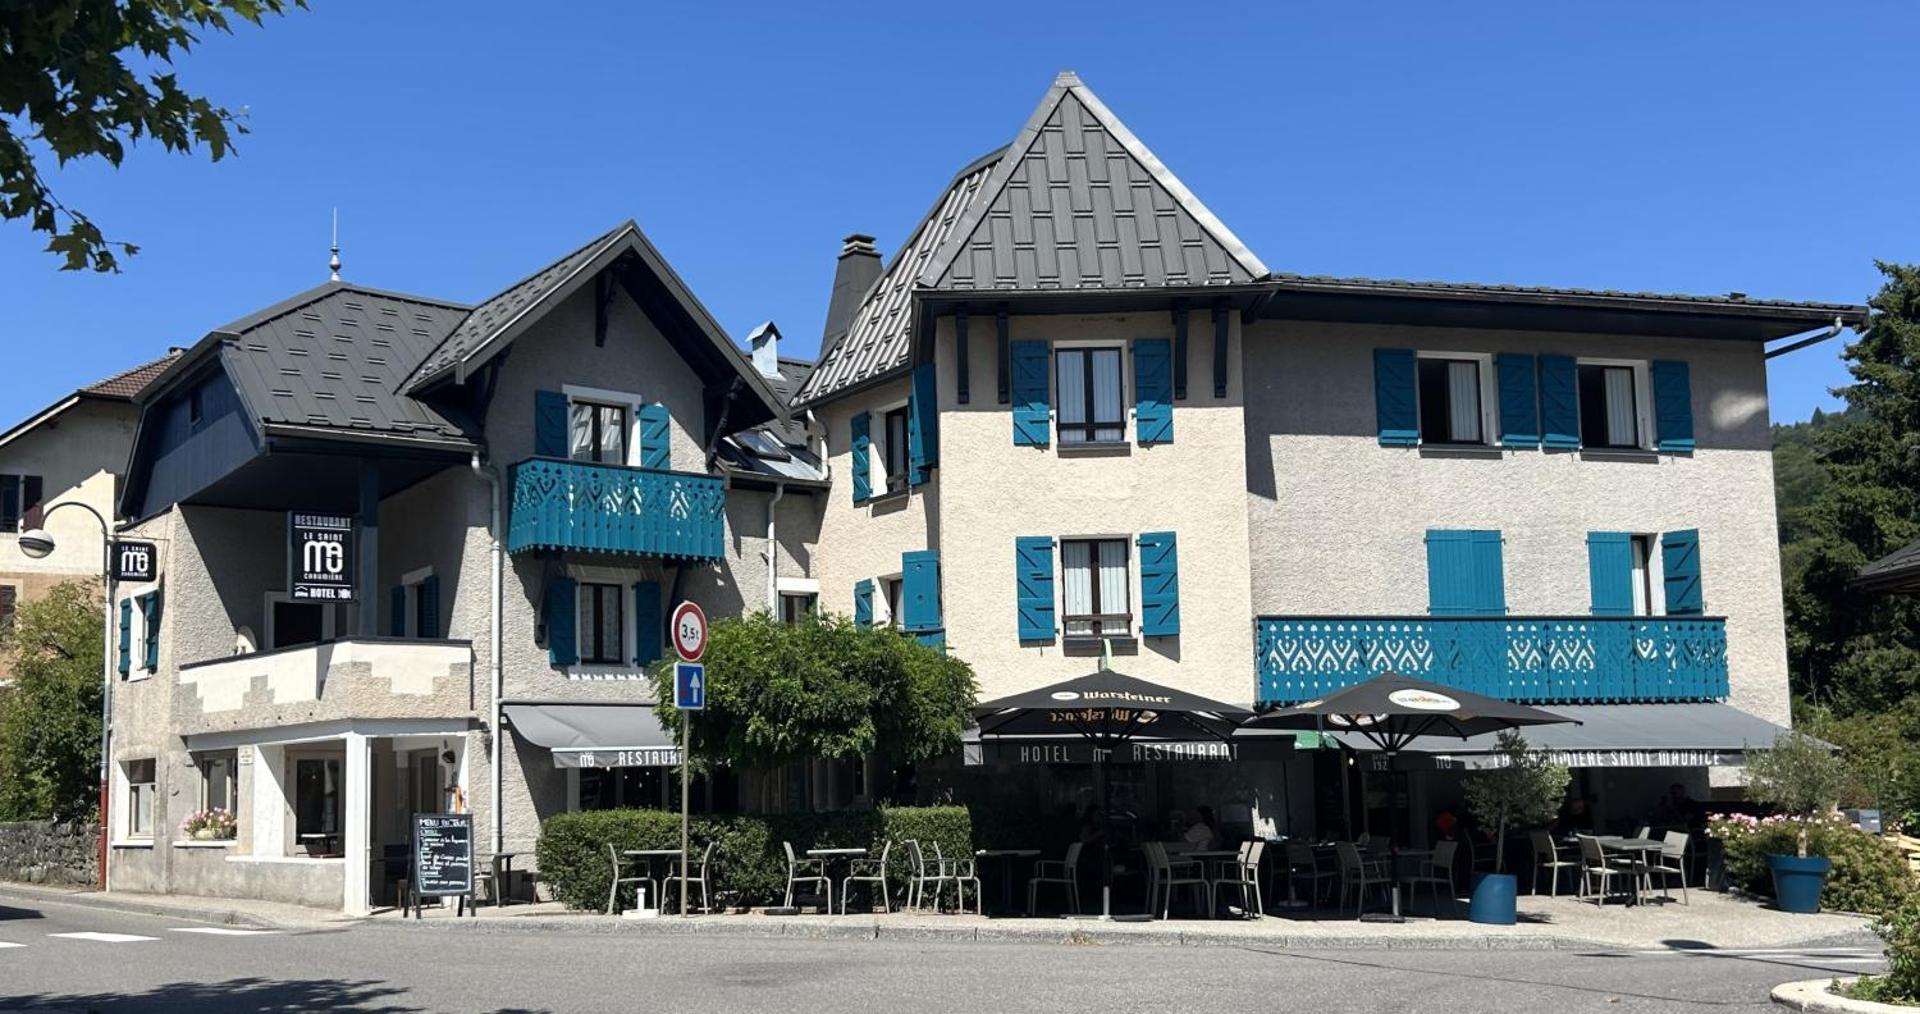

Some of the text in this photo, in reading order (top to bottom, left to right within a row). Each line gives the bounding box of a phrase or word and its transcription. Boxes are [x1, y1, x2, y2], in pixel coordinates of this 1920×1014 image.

[294, 514, 352, 528] RESTAURANT
[310, 588, 336, 598] HOTEL
[681, 624, 700, 641] 3,5t
[1083, 691, 1172, 703] Warsteiner
[618, 750, 683, 766] RESTAUR
[1020, 743, 1239, 763] HOTEL RESTAURANT
[1610, 751, 1651, 766] SAINT
[1658, 750, 1720, 766] MAURICE
